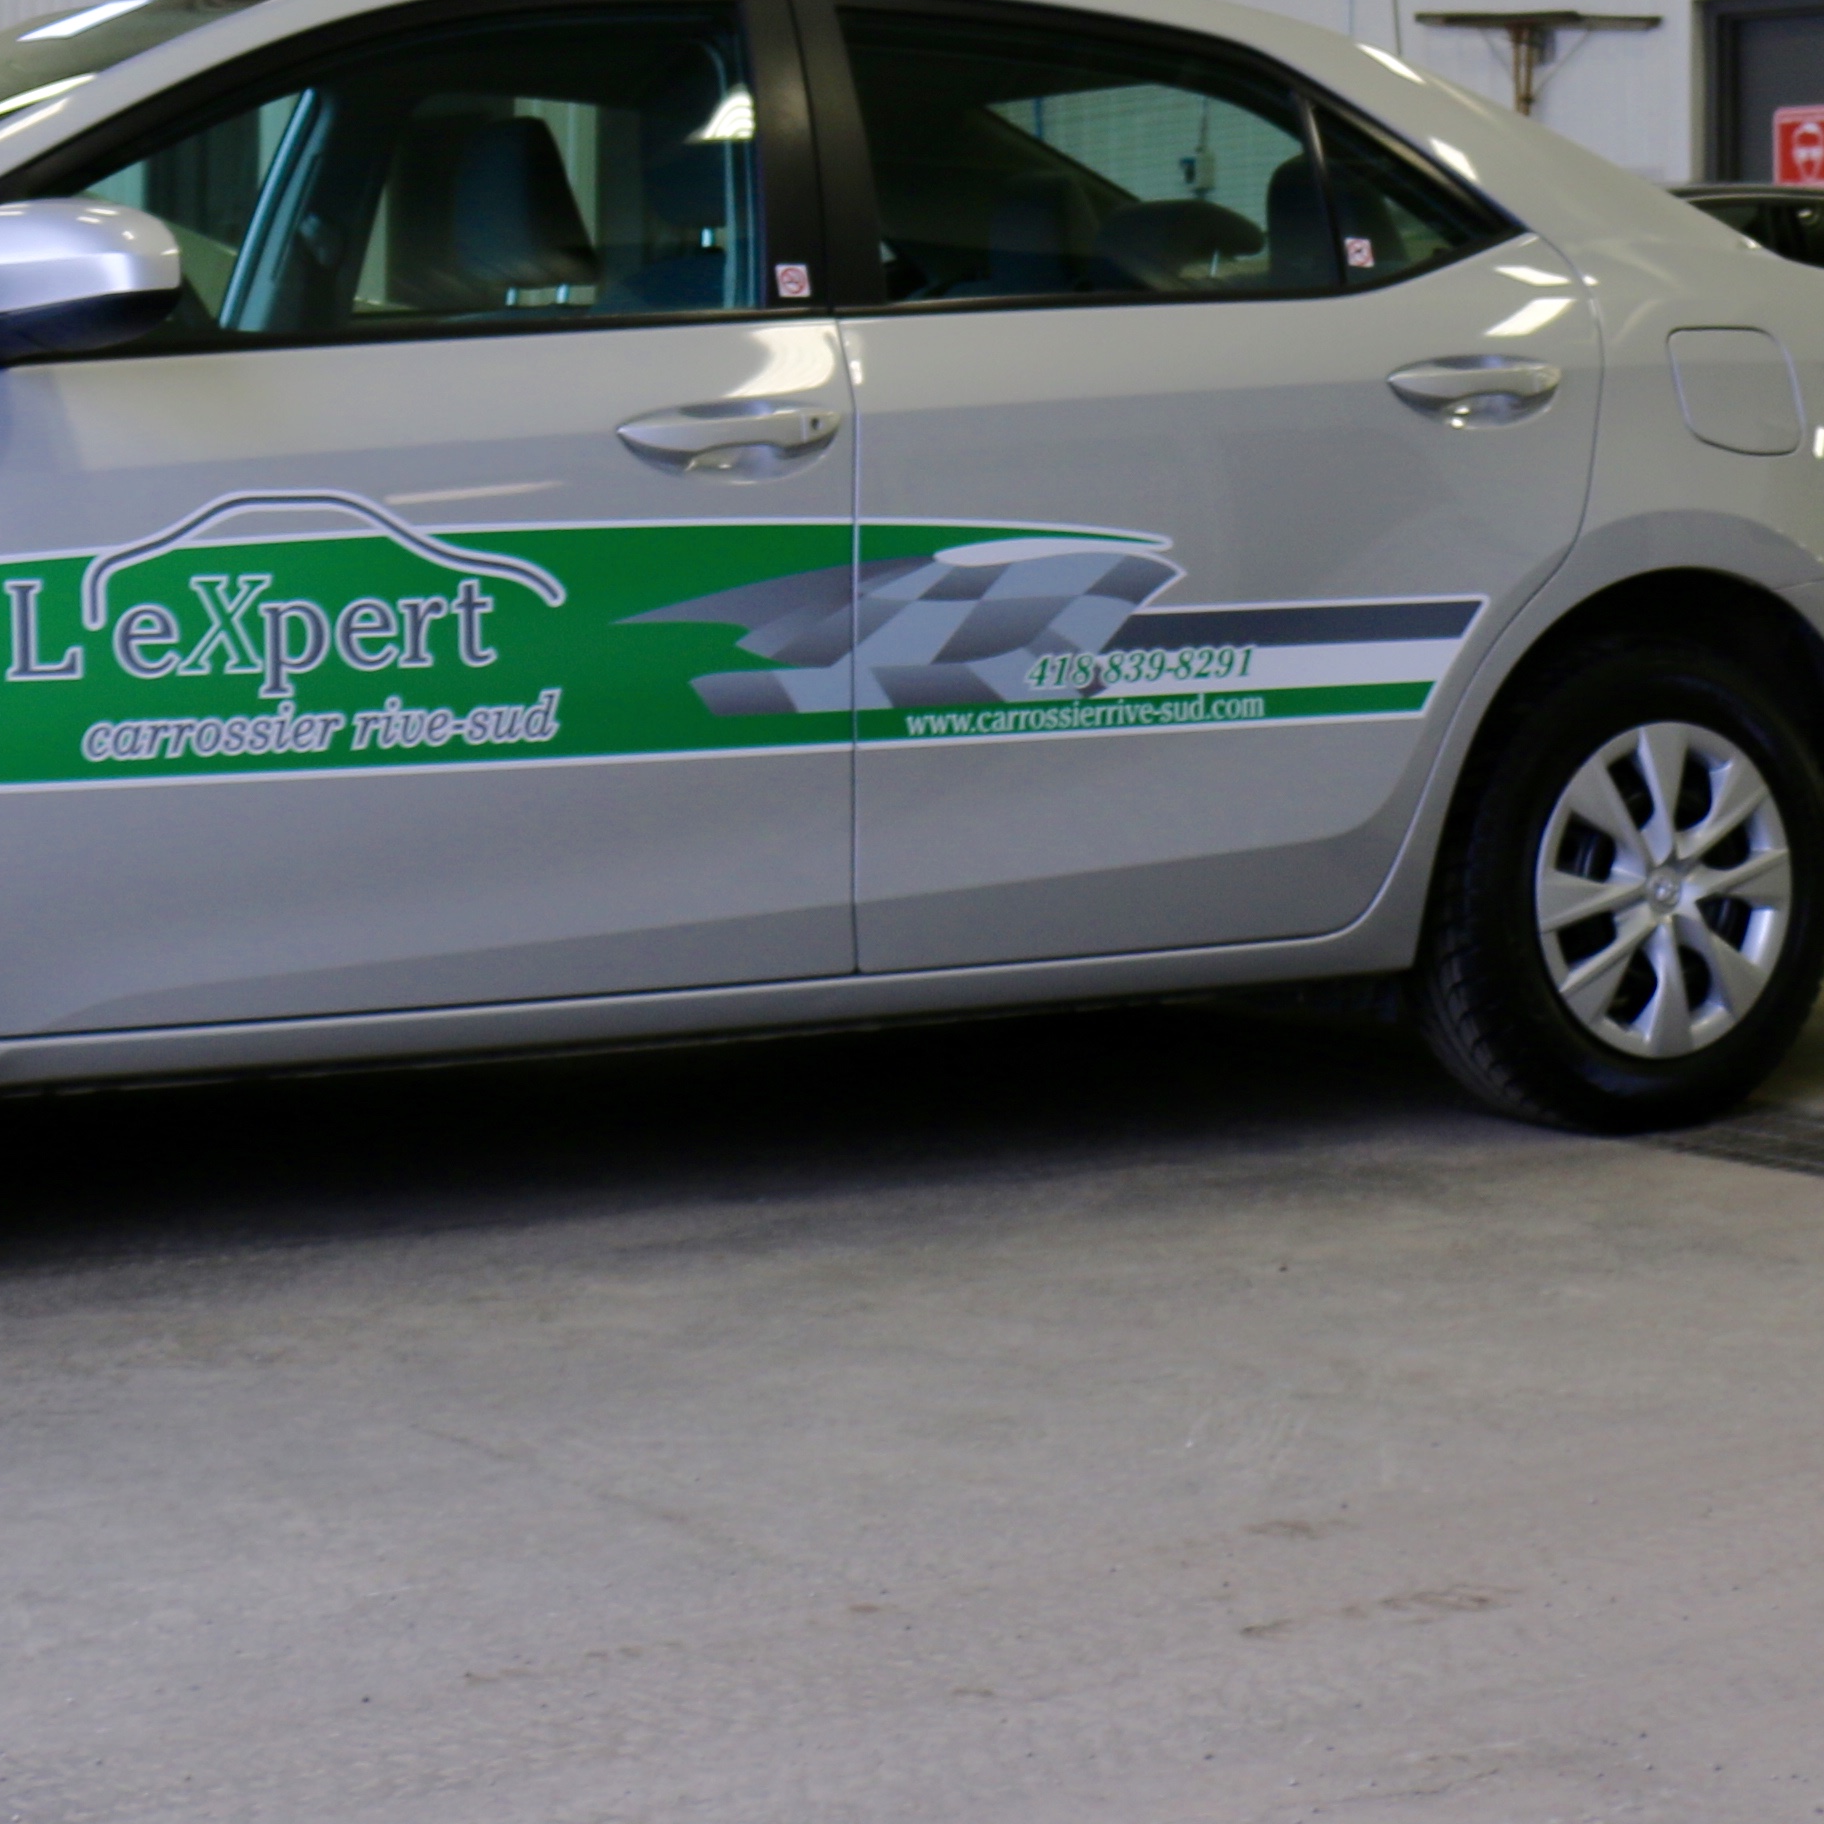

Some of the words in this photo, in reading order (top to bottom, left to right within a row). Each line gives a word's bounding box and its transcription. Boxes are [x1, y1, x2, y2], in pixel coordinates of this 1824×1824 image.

[1027, 653, 1097, 689] 418
[1102, 646, 1255, 686] 839-8291
[82, 703, 344, 761] carrossier
[351, 688, 561, 751] rive-sud
[905, 694, 1265, 736] www.carrossierrive-sud.com
